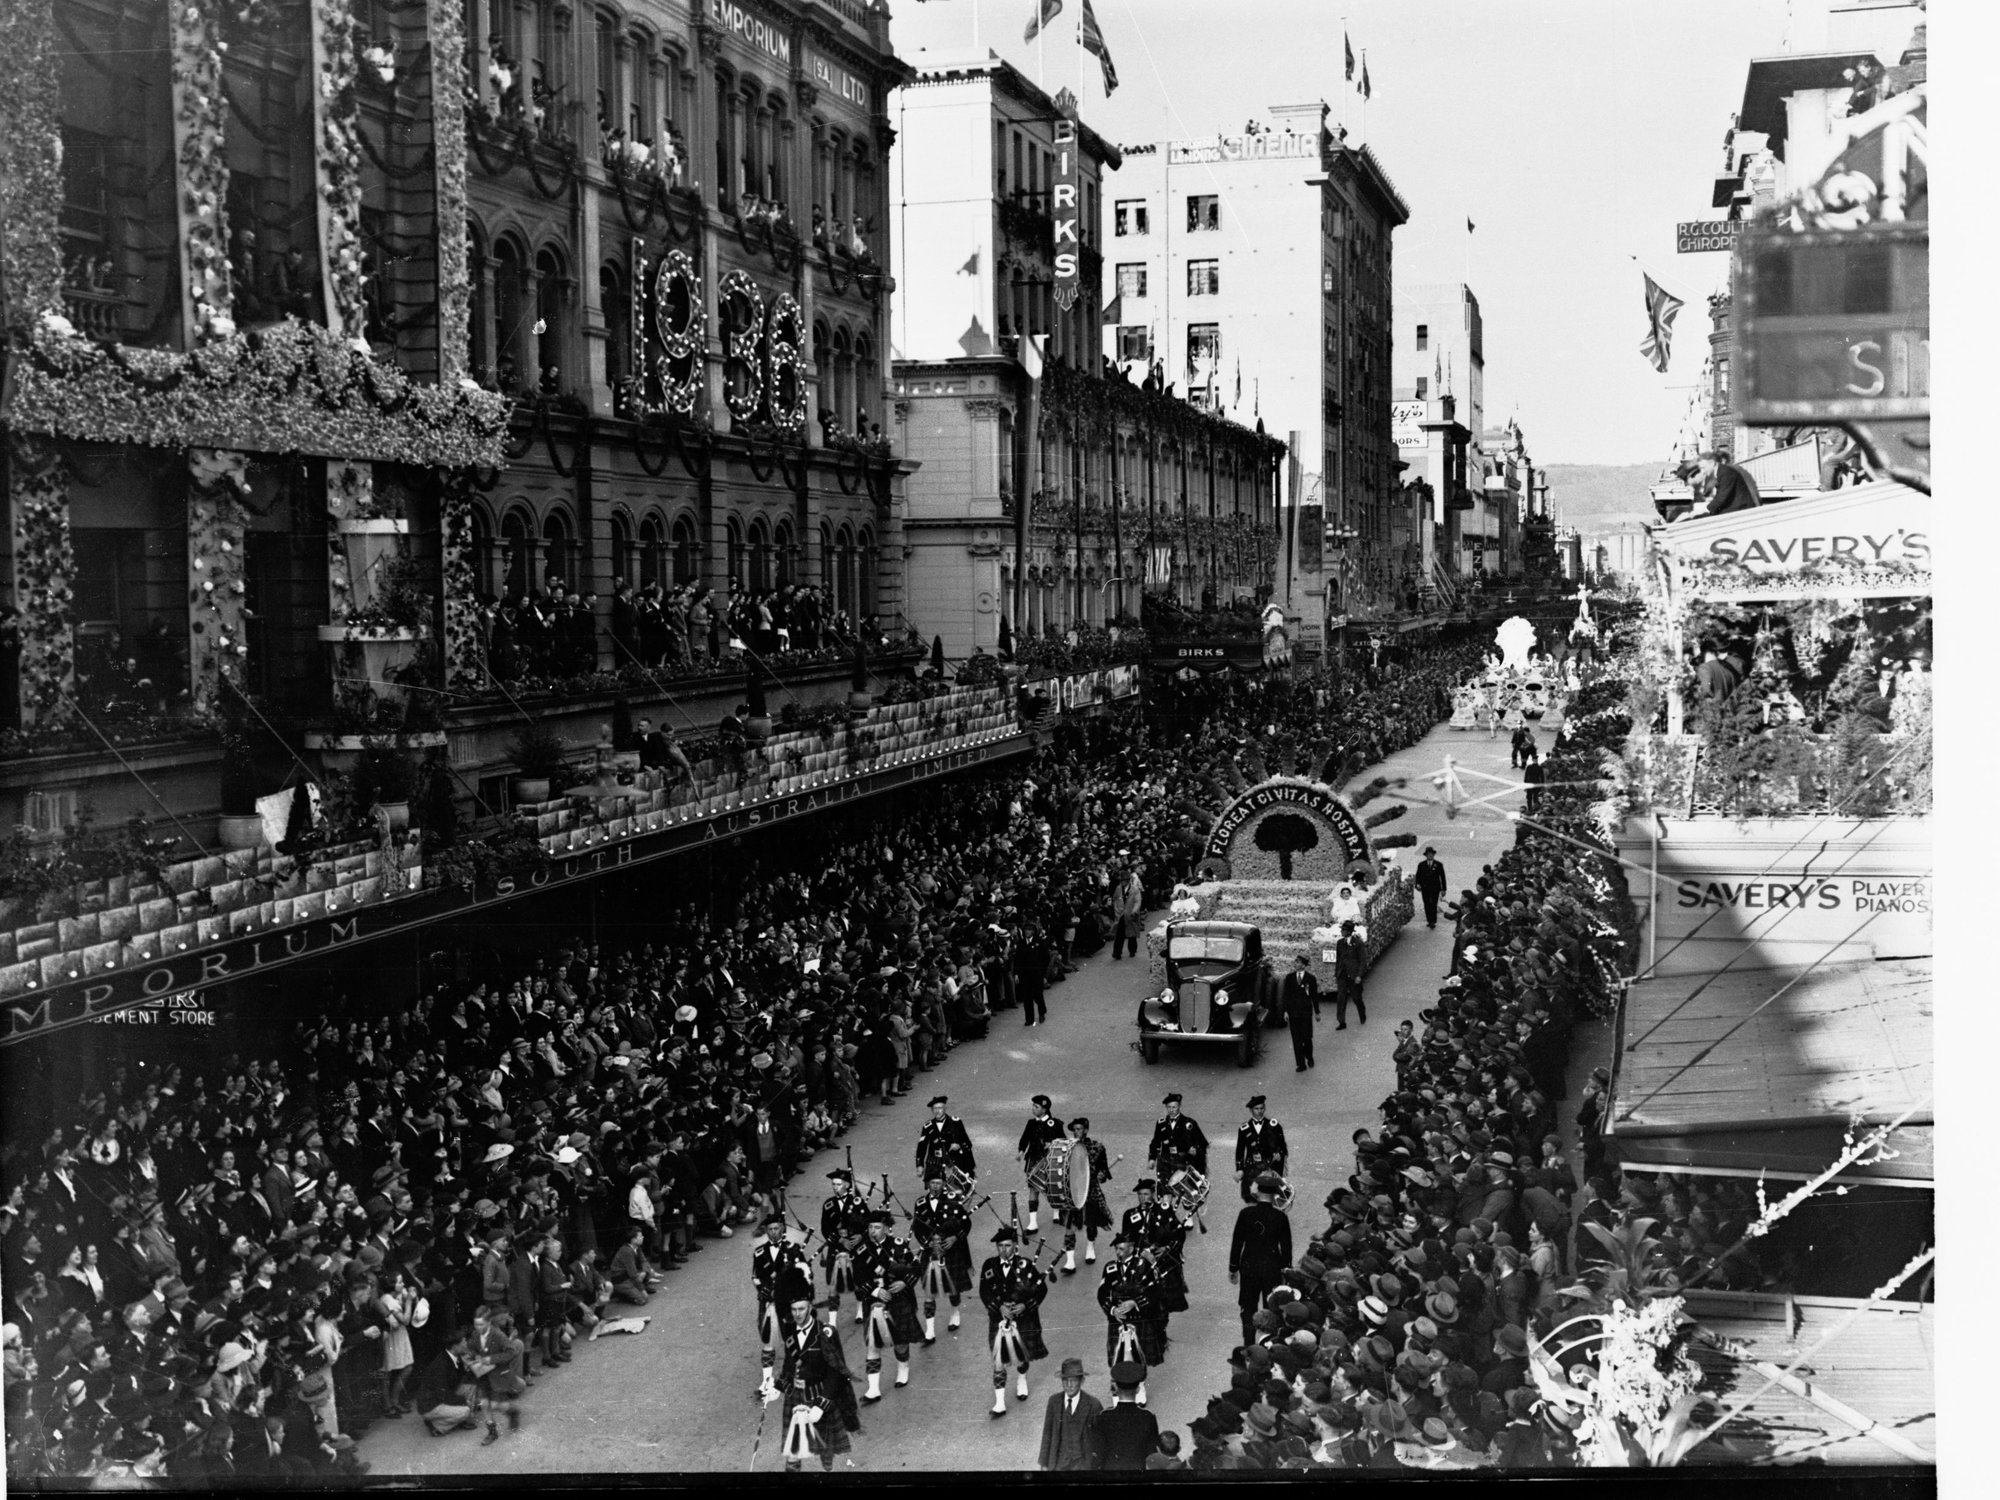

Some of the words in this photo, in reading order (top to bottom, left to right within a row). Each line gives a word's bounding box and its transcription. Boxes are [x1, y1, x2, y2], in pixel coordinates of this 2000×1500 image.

[712, 0, 790, 63] EMPORIUM
[1223, 134, 1318, 159] CINEMA
[1054, 120, 1077, 278] BIRKS
[631, 236, 808, 431] 1936
[1710, 529, 1932, 564] SAVERY'S
[1178, 648, 1225, 657] BIRKS
[496, 843, 633, 896] SOUTH
[704, 782, 861, 840] AUSTRALIA
[1211, 798, 1259, 856] FLOREAT
[1257, 787, 1321, 809] CIVITAS
[1321, 802, 1363, 860] NOSTRA
[1677, 878, 1841, 910] SAVERY'S
[1852, 880, 1926, 896] PLAYER
[1856, 897, 1930, 912] PIANOS
[1324, 951, 1336, 961] 70
[169, 1010, 216, 1026] STORE
